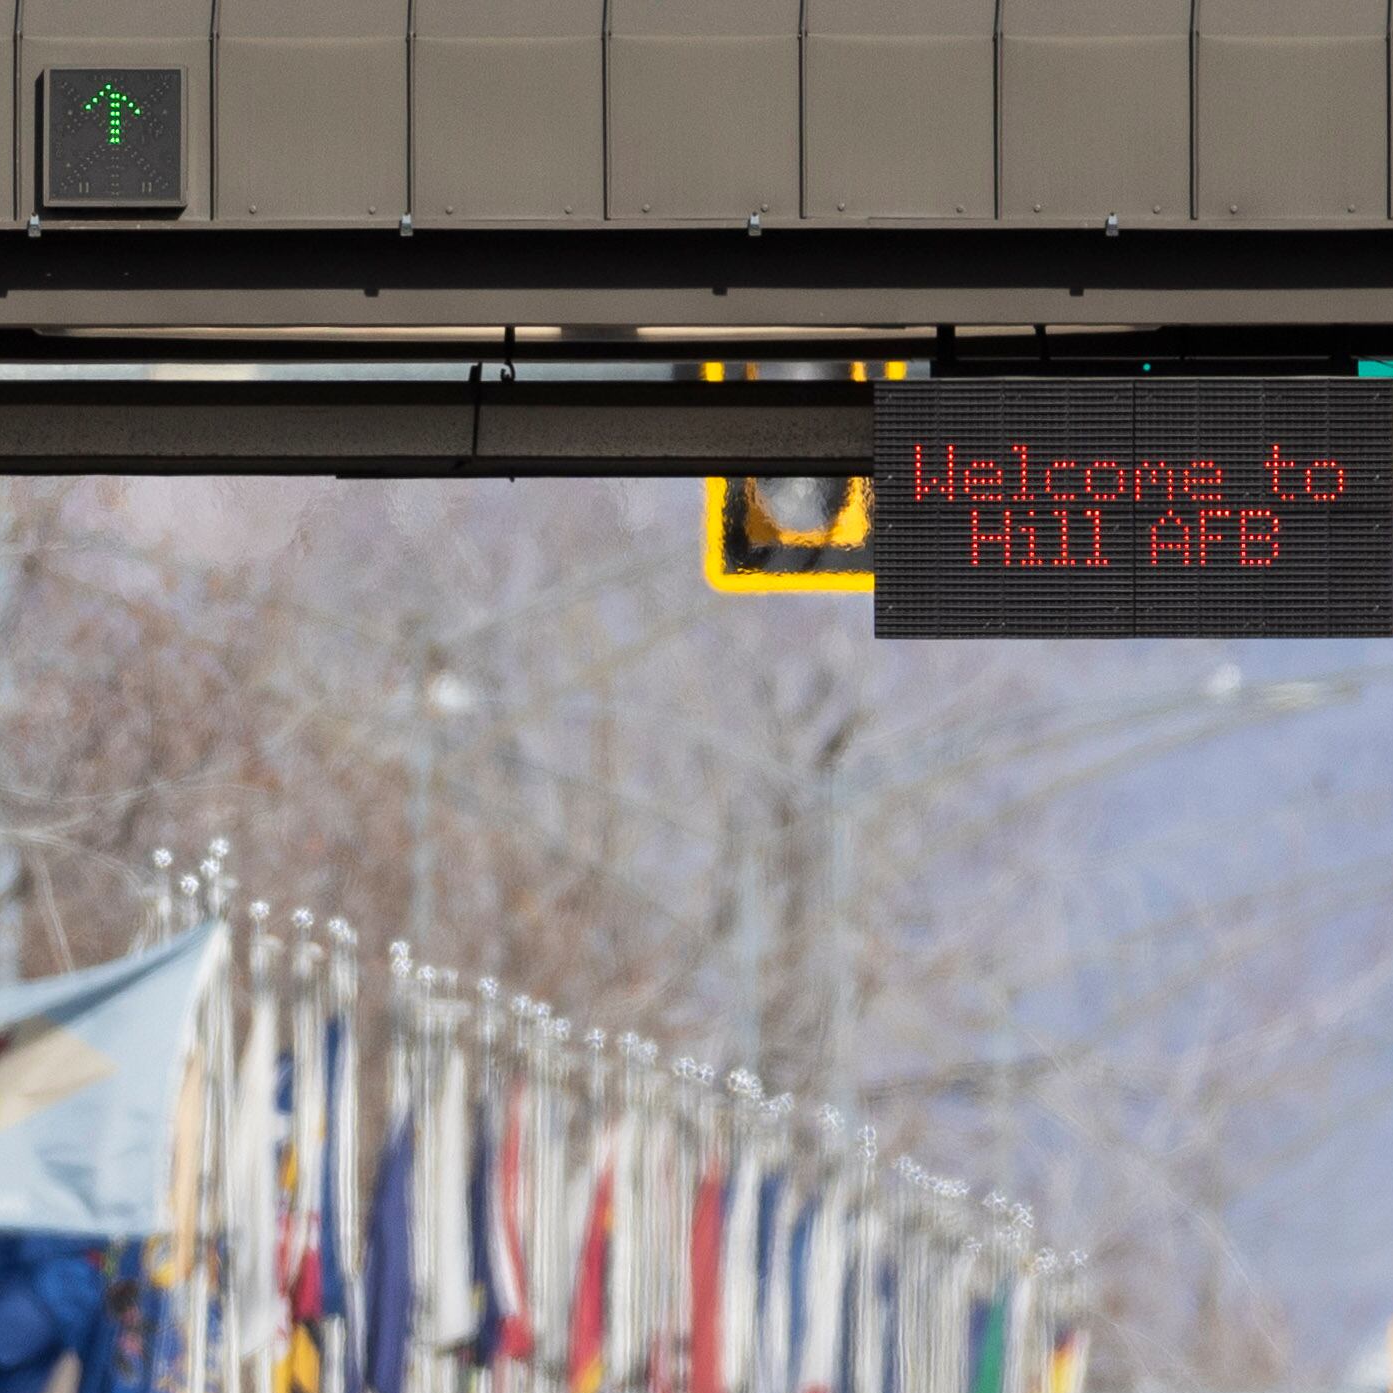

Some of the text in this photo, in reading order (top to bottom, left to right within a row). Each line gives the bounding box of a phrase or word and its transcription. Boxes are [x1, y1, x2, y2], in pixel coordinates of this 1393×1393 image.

[915, 444, 1345, 501] Welcome to
[971, 509, 1280, 567] Hill AFB
